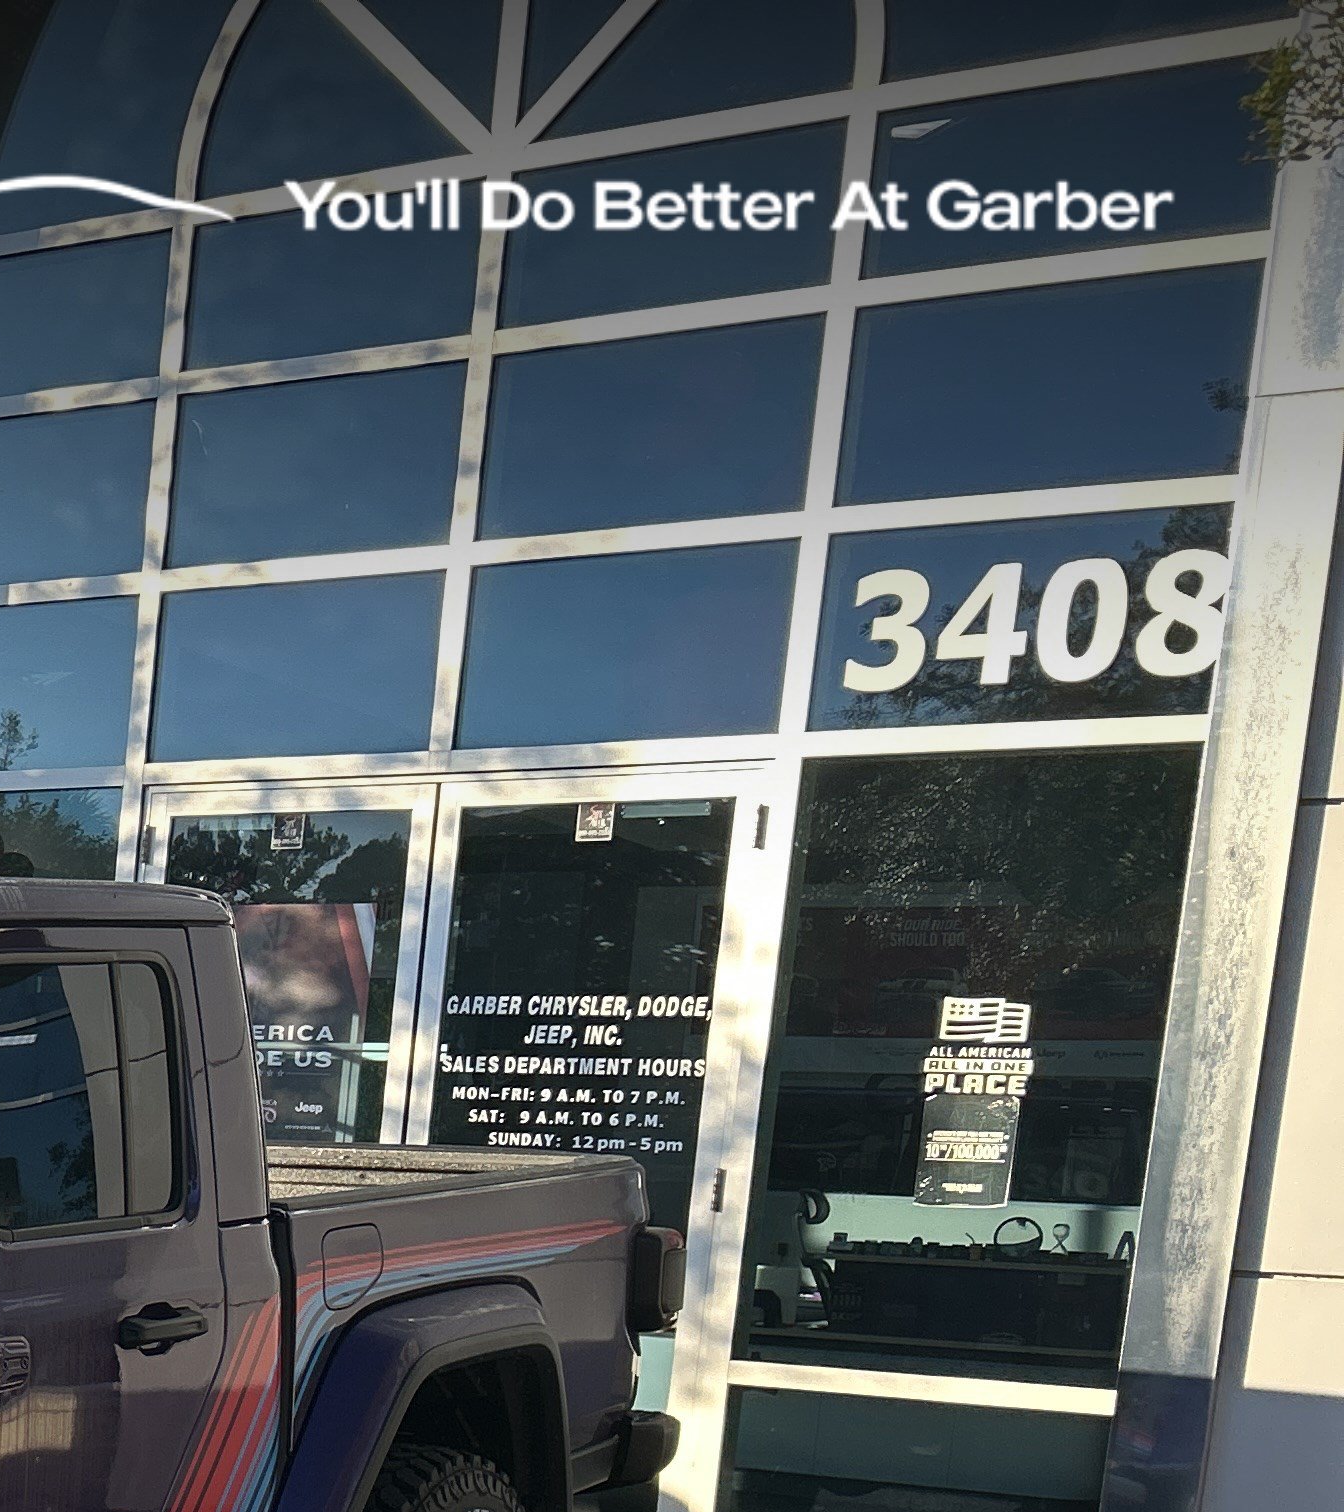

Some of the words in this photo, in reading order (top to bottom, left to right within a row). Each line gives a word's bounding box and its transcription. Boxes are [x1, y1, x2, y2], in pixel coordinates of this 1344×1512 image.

[843, 548, 1229, 693] 3408
[447, 995, 521, 1016] GARBER
[528, 995, 632, 1020] CHRYSLER,
[638, 995, 712, 1021] DODGE,
[253, 1025, 334, 1042] ERICA
[524, 1024, 577, 1048] JEEP,
[583, 1024, 623, 1046] INC.
[294, 1051, 332, 1068] US
[930, 1046, 952, 1057] ALL
[958, 1046, 1032, 1058] AMERICAN
[441, 1055, 499, 1073] SALES
[504, 1056, 632, 1075] DEPARTMENT
[638, 1058, 705, 1078] HOURS
[928, 1060, 958, 1071] ALL
[966, 1061, 984, 1071] IN
[991, 1061, 1027, 1072] ONE
[924, 1073, 1028, 1095] PLACE
[540, 1088, 551, 1102] 9
[556, 1088, 596, 1103] A.M.
[602, 1089, 624, 1103] TO
[630, 1090, 641, 1104] 7
[646, 1090, 685, 1105] P.M.
[294, 1101, 324, 1115] Jeep
[468, 1109, 505, 1124] SAT:
[519, 1110, 530, 1124] 9
[535, 1111, 574, 1125] A.M.
[581, 1112, 602, 1126] TO
[609, 1112, 620, 1127] 6
[625, 1113, 664, 1128] P.M.
[487, 1132, 562, 1148] SUNDAY:
